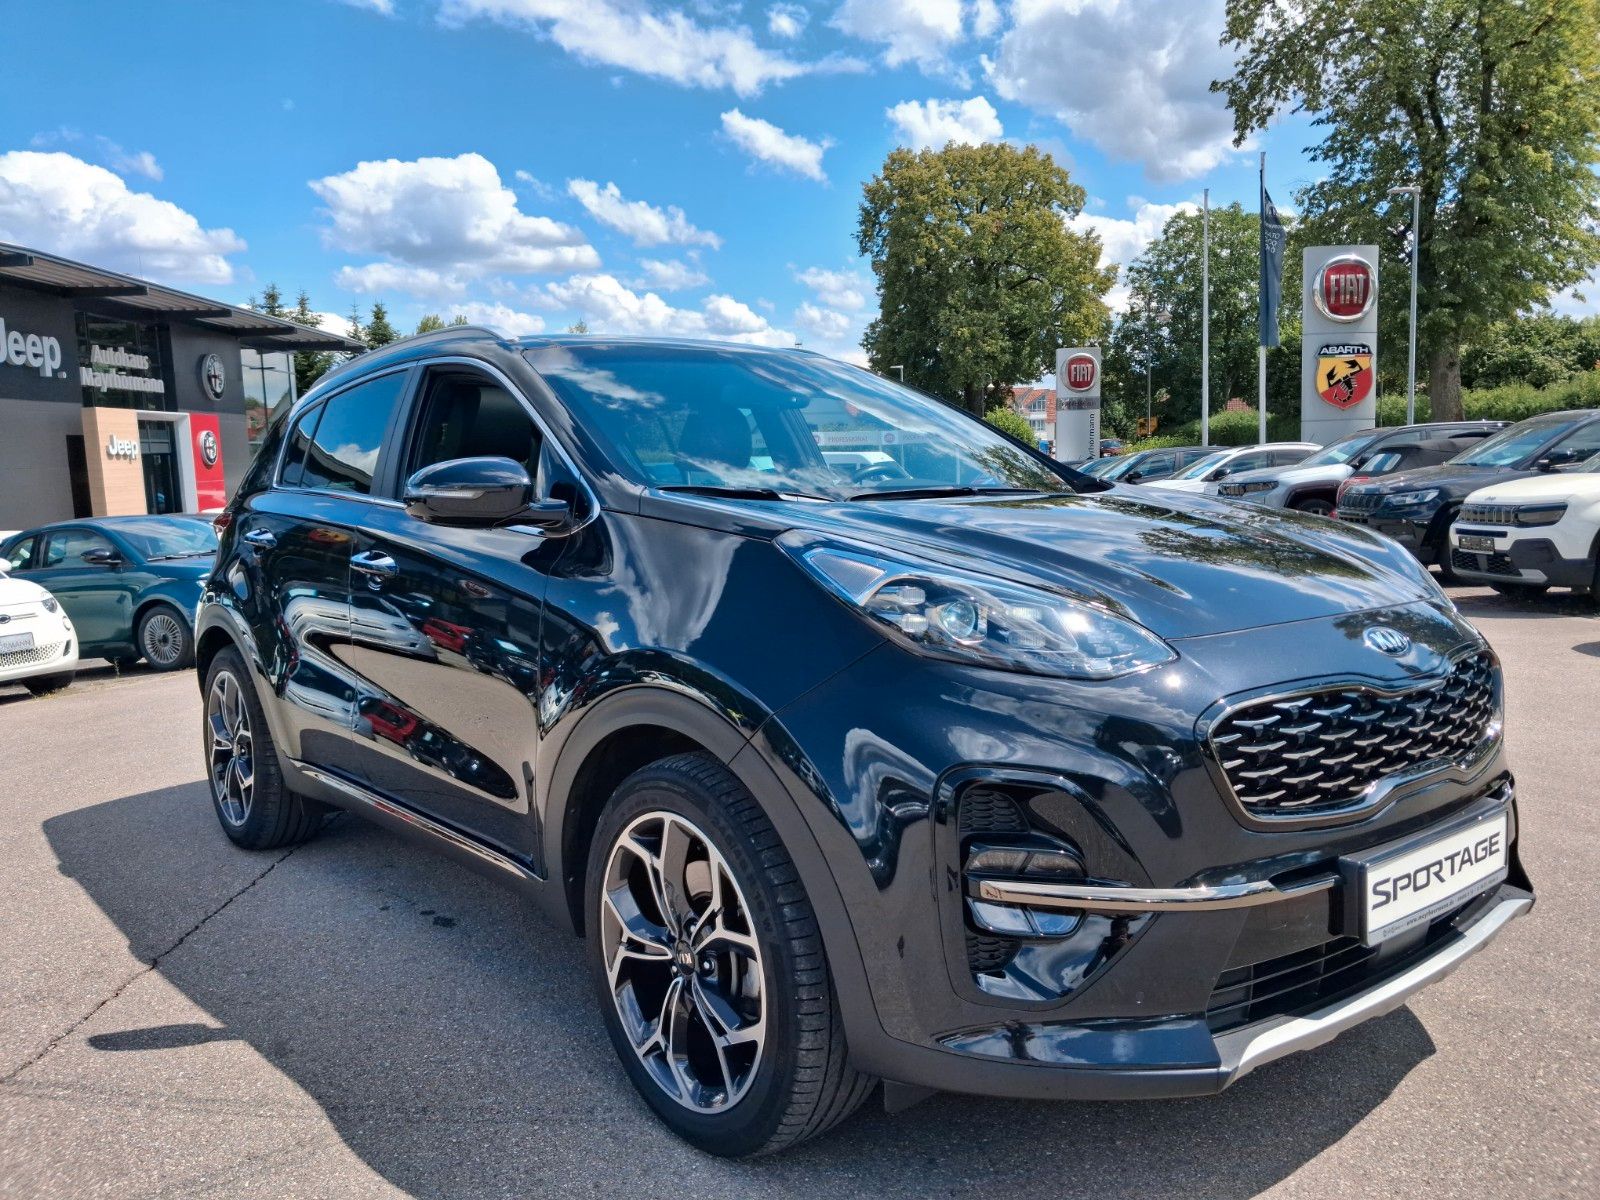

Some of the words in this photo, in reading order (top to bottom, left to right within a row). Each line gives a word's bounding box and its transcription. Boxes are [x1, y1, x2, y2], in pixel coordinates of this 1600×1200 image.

[1330, 274, 1366, 305] FIAT
[91, 344, 149, 370] Autohaus
[1320, 345, 1369, 354] ABARTH
[1071, 364, 1092, 382] FIAT
[108, 435, 139, 459] Jeep
[1371, 831, 1501, 911] SPORTAGE
